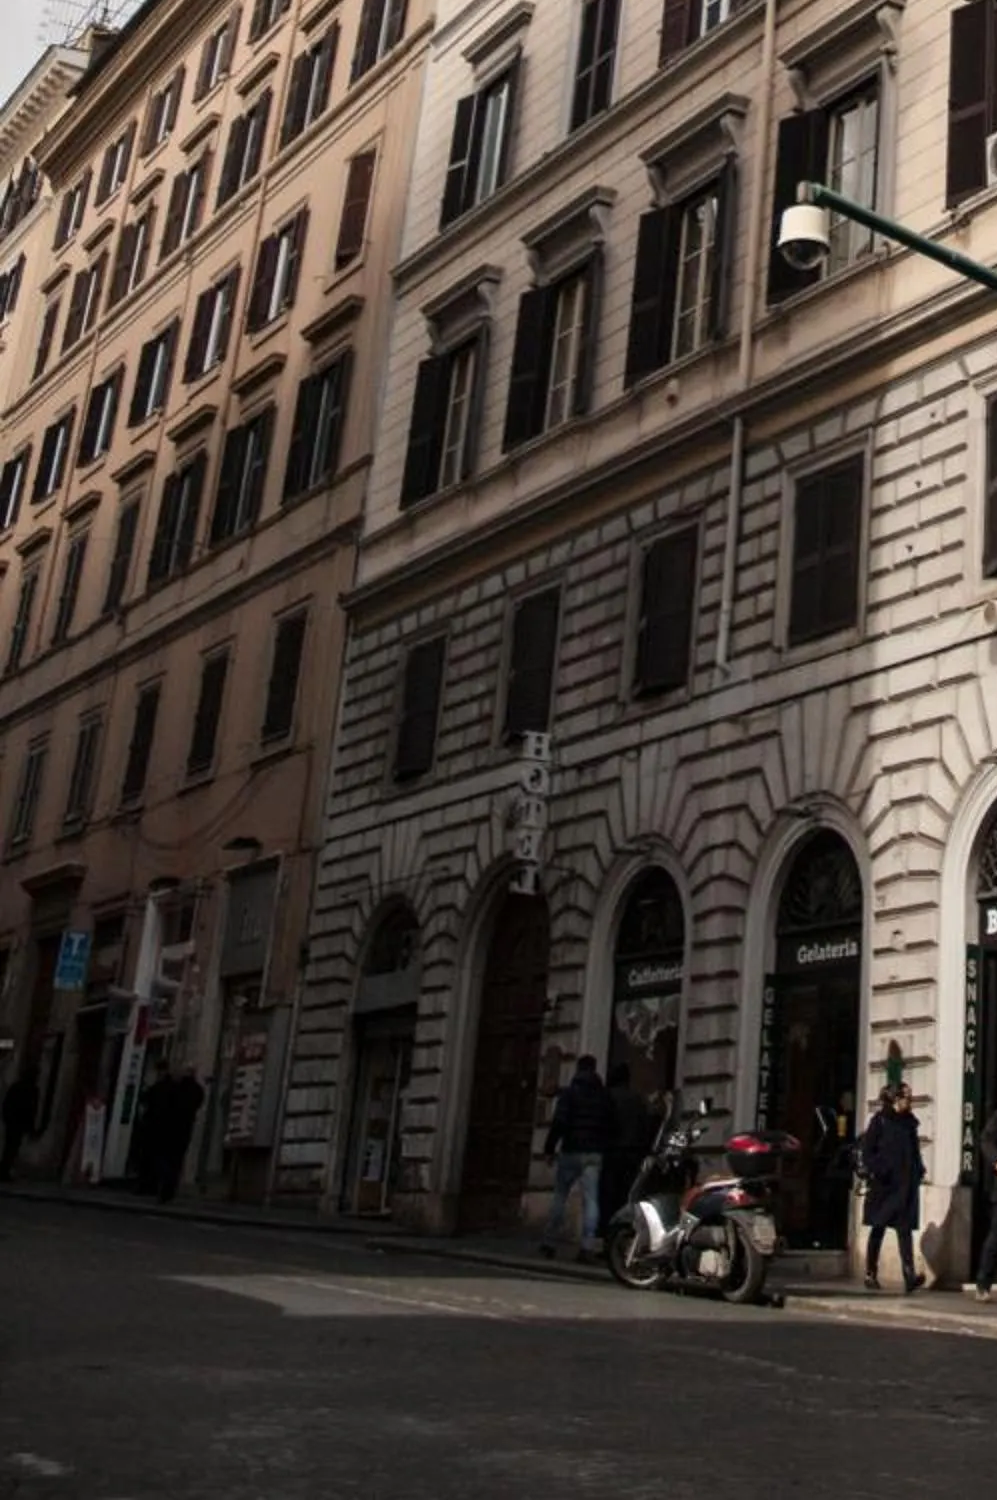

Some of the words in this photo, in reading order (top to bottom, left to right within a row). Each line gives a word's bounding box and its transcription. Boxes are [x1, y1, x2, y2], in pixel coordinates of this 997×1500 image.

[797, 938, 858, 963] Gelateria
[757, 986, 776, 1131] GELATER
[964, 958, 977, 1074] SNACK
[962, 1101, 974, 1172] BAR
